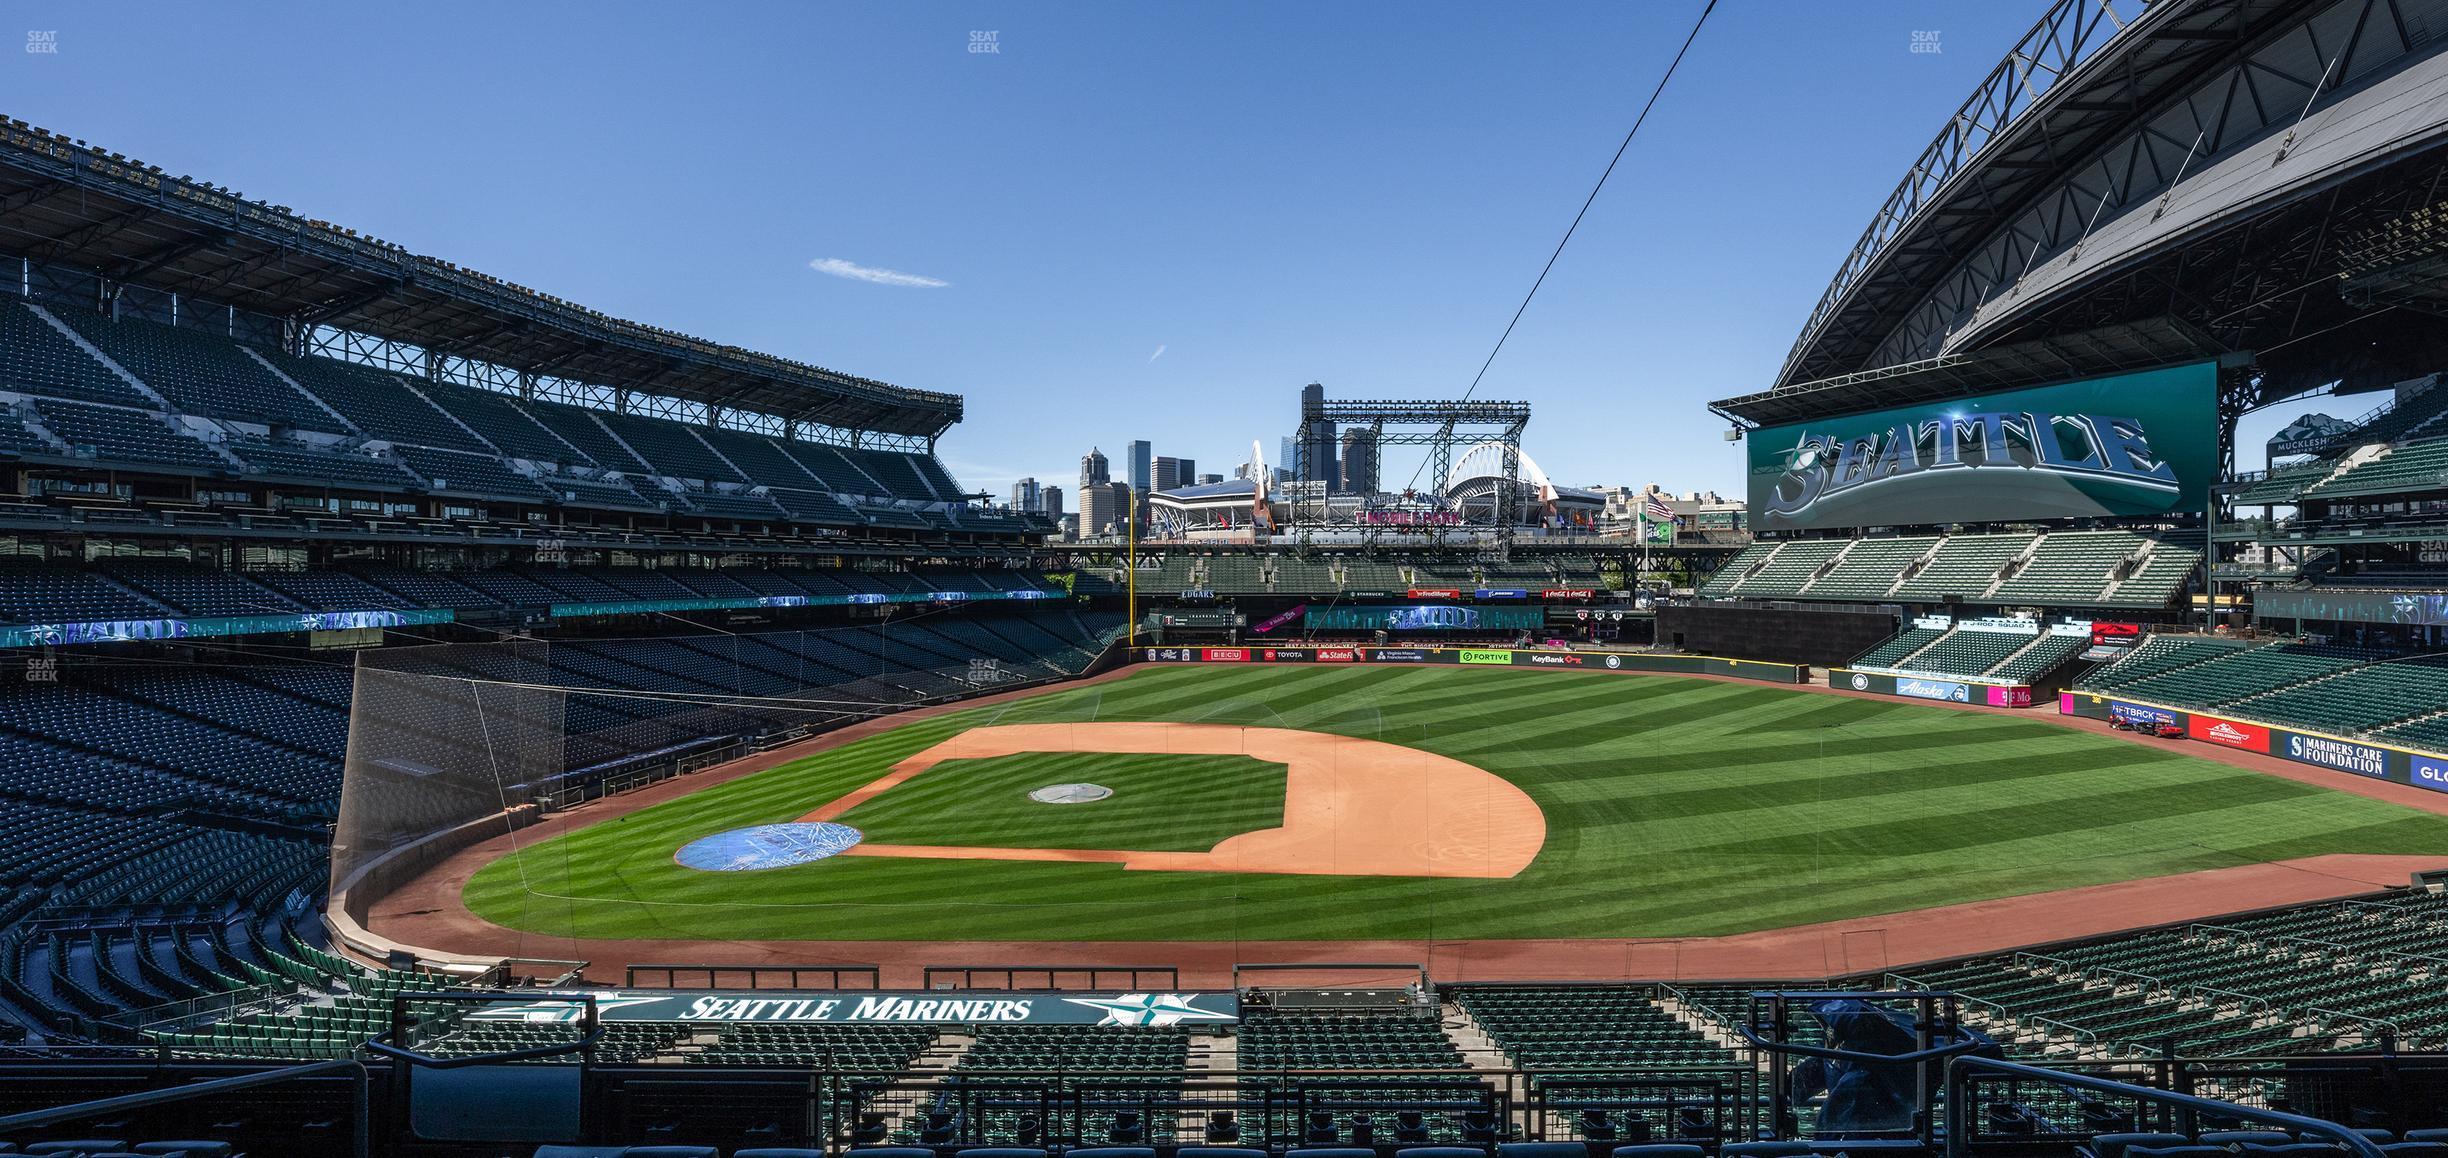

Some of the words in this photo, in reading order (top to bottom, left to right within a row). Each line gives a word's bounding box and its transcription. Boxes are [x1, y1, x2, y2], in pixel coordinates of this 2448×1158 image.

[1763, 410, 2180, 517] SEATTLE
[1355, 511, 1420, 525] T-MOBILE
[1423, 511, 1460, 525] PARK
[1213, 651, 1240, 659] BECU
[1474, 653, 1509, 661] FORTIVE
[1532, 655, 1565, 663] KeyBank
[1899, 681, 1945, 698] Alaska
[2306, 737, 2353, 757] MARINERS
[2356, 747, 2383, 762] CARE
[2306, 747, 2383, 775] FOUNDATION
[678, 996, 842, 1021] SEATTLE
[847, 996, 1035, 1021] MARINERS
